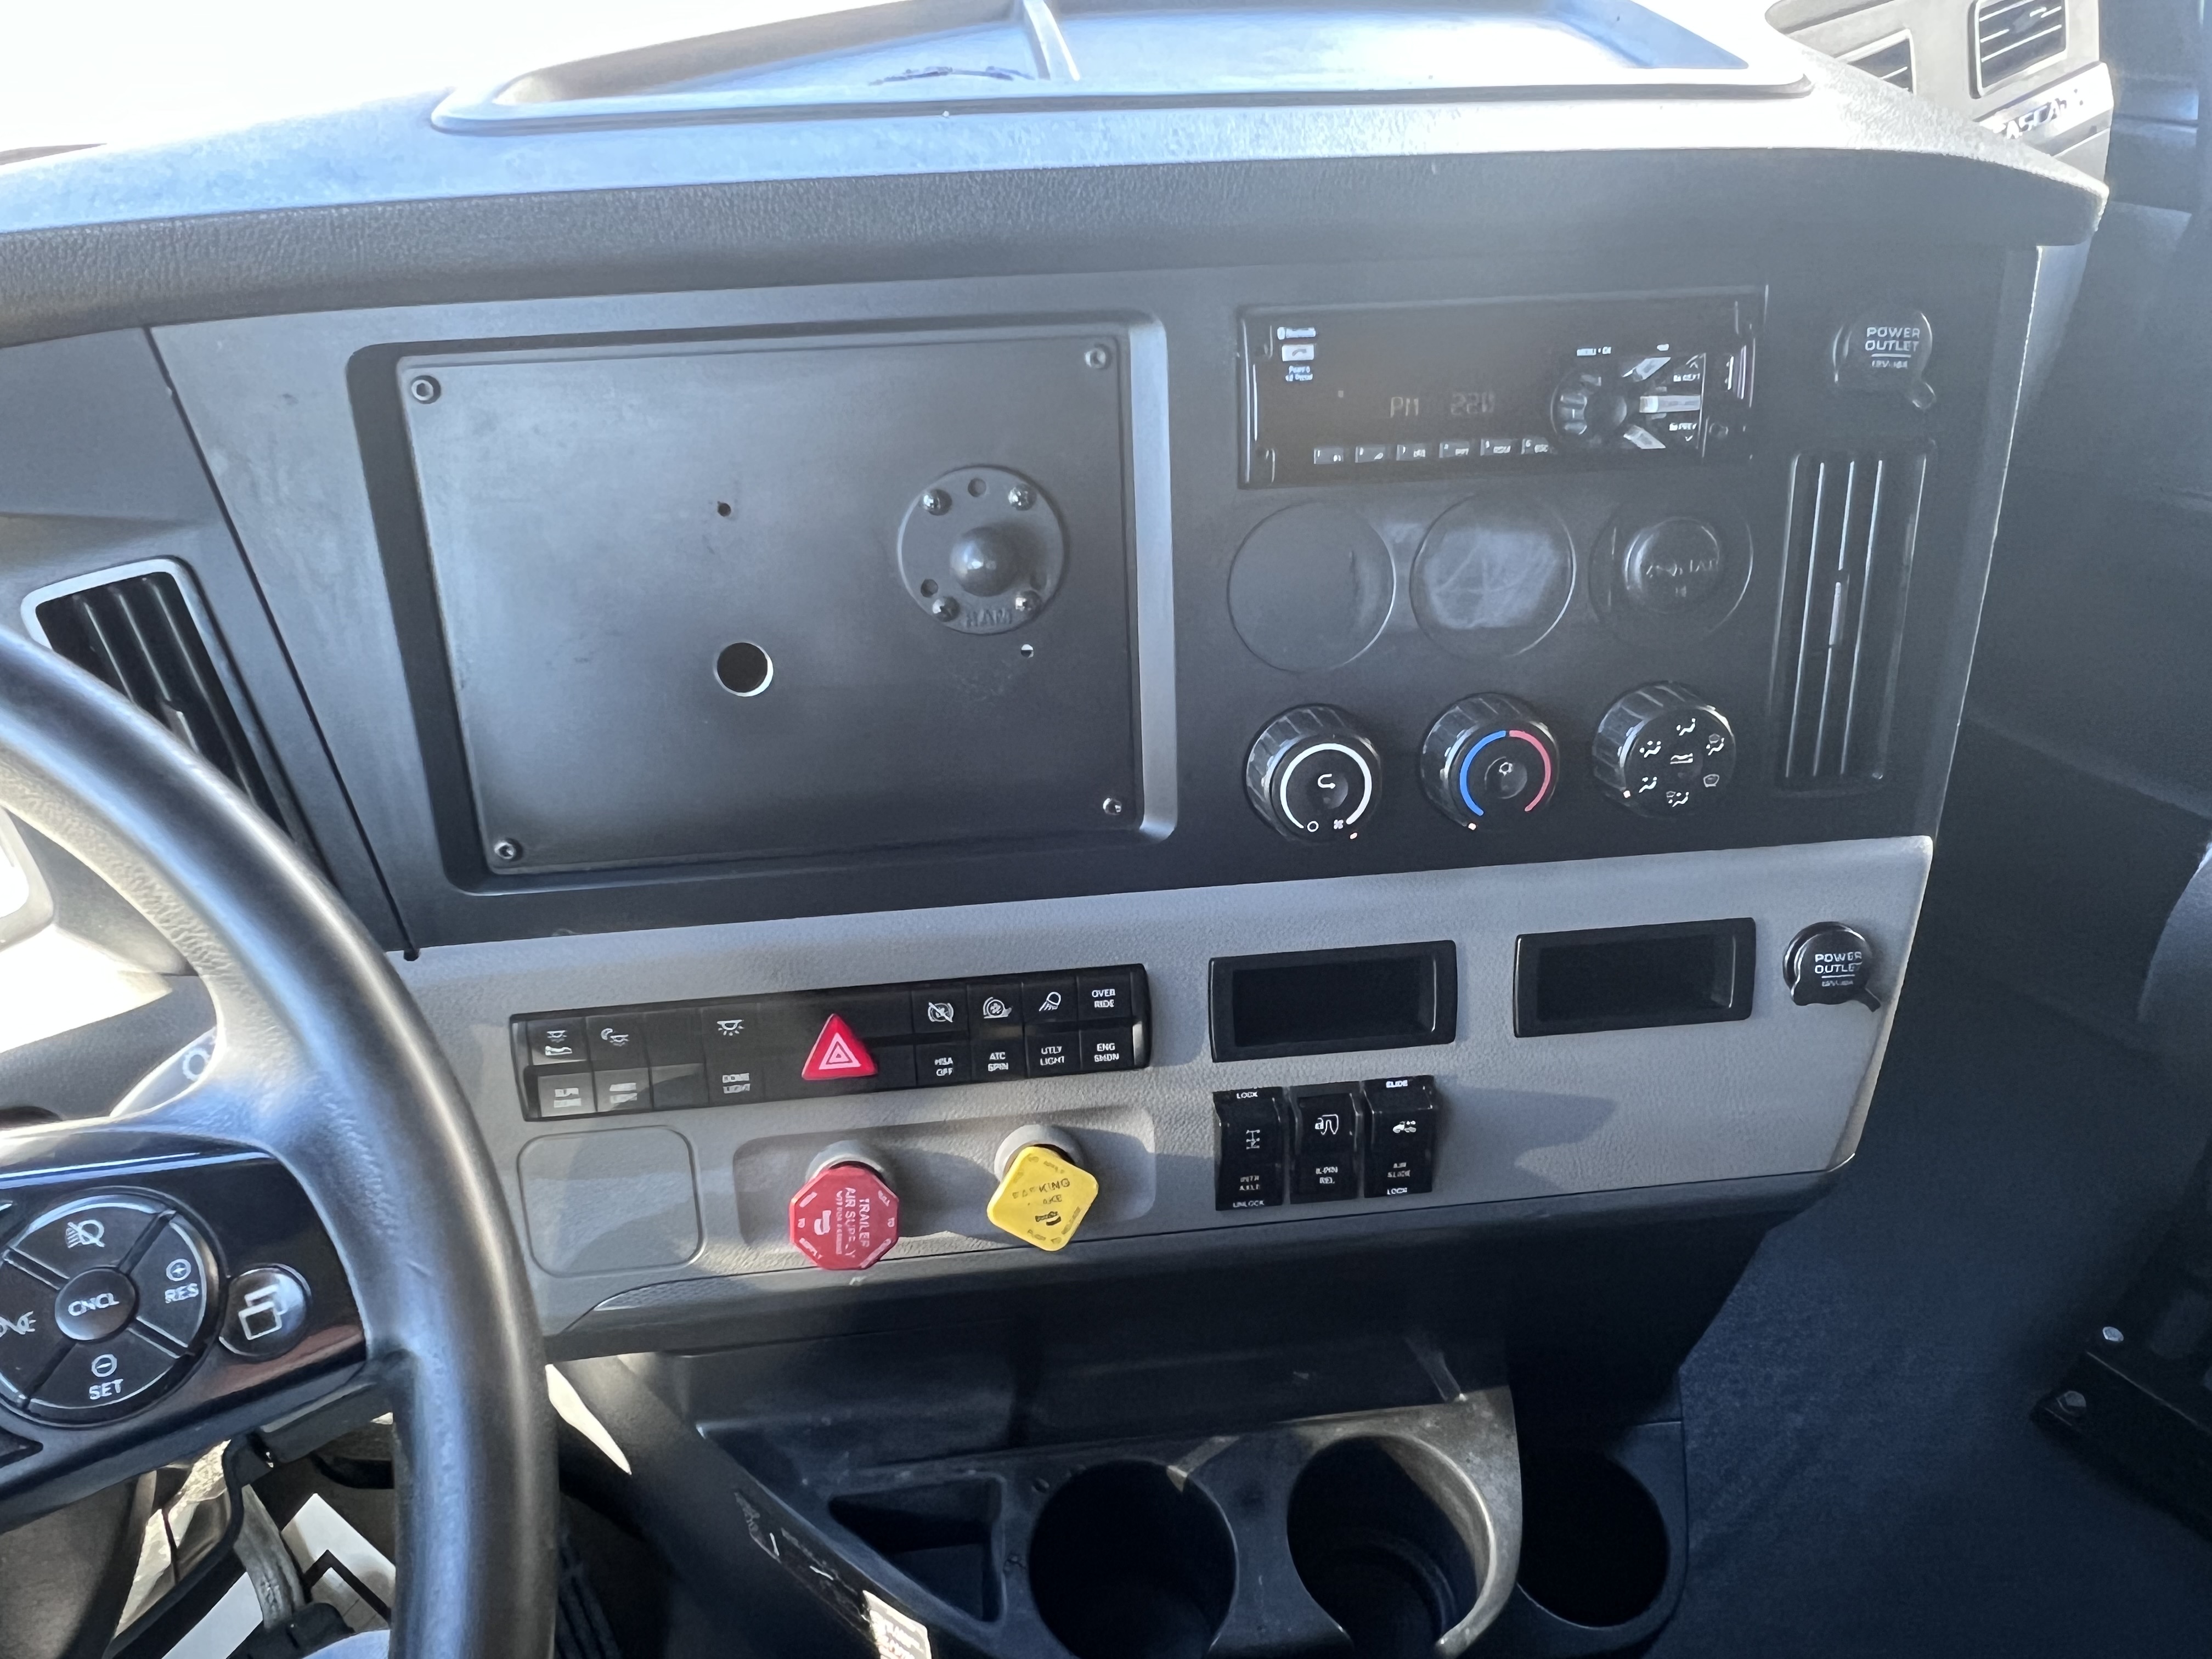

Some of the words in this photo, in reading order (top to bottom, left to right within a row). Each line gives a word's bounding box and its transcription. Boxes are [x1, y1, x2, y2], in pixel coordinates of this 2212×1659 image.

[1866, 326, 1920, 338] POWER
[1865, 340, 1920, 352] OUTLET
[1814, 951, 1862, 963] POWER
[1814, 961, 1863, 974] OUTLET
[1091, 988, 1116, 998] OVER
[1096, 1042, 1116, 1052] ENG
[989, 1051, 1006, 1060] ATC
[936, 1067, 953, 1076] OFF
[844, 1187, 856, 1208] AIR
[859, 1198, 871, 1248] TRAILER
[844, 1210, 857, 1259] SUPPY
[164, 1282, 200, 1304] RES
[88, 1378, 125, 1400] SET
